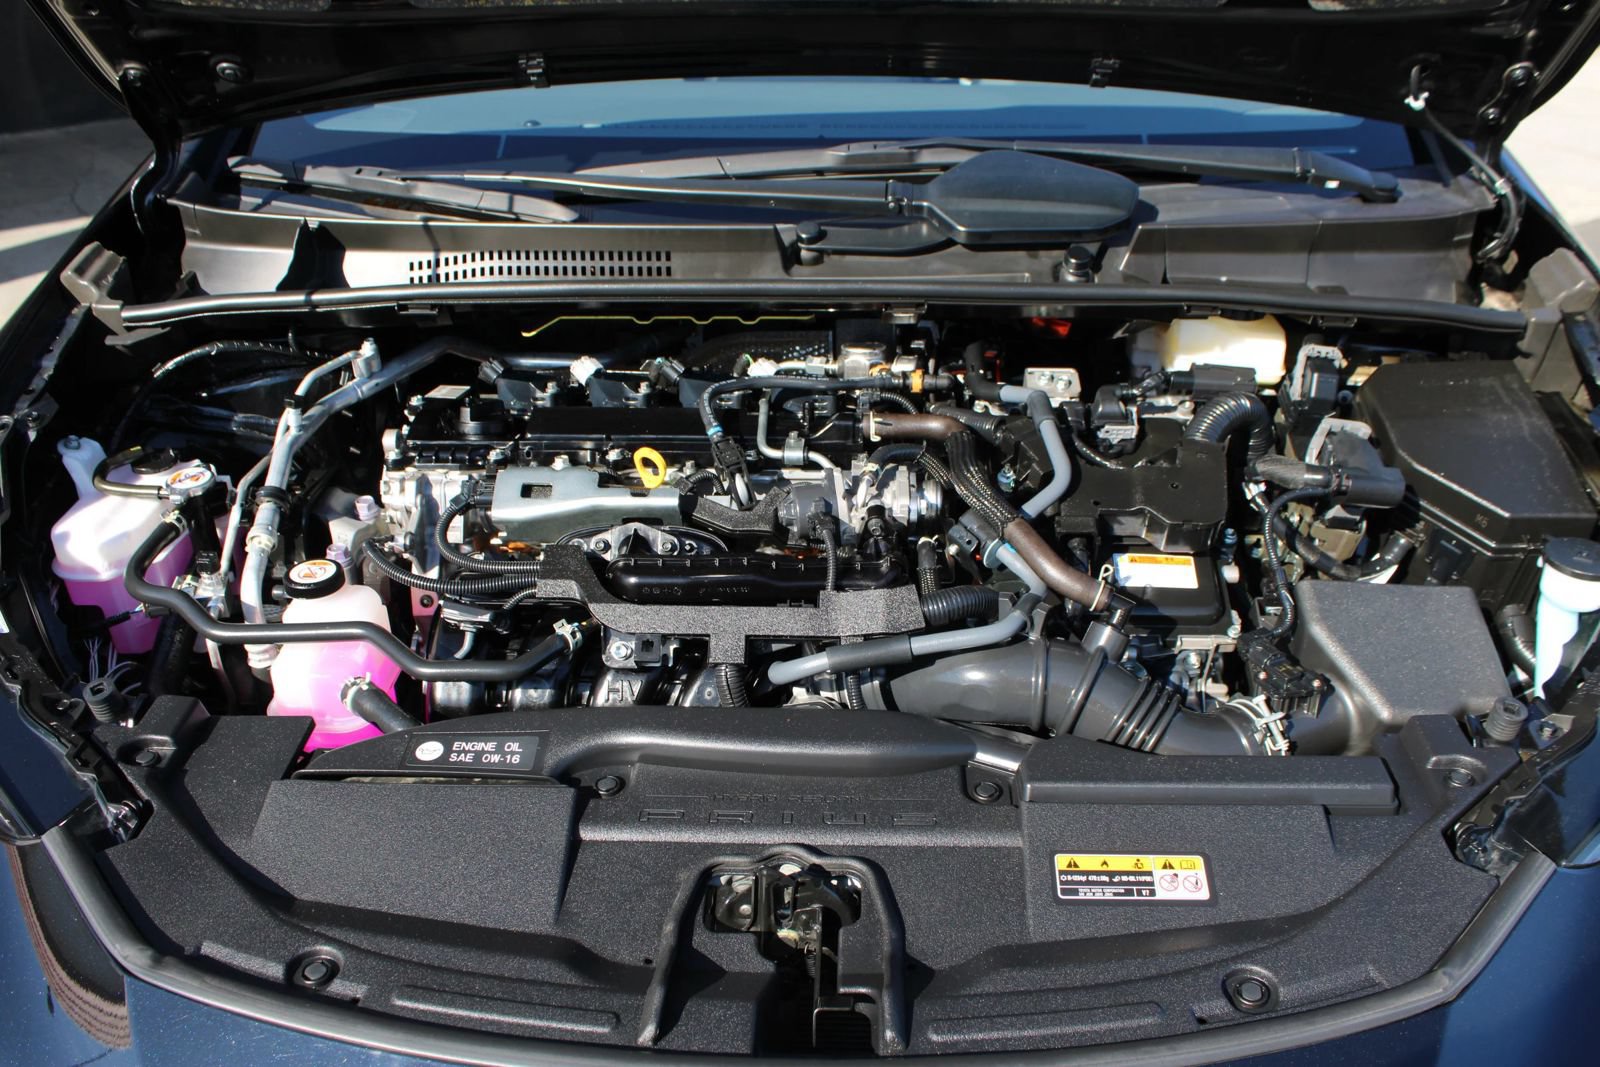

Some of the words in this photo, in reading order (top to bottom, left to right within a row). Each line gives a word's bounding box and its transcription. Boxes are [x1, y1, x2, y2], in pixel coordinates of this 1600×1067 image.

[452, 741, 497, 751] ENGINE
[504, 742, 523, 752] OIL
[449, 753, 475, 763] SAE
[481, 754, 521, 764] 0W-16
[638, 808, 938, 826] PRIUS
